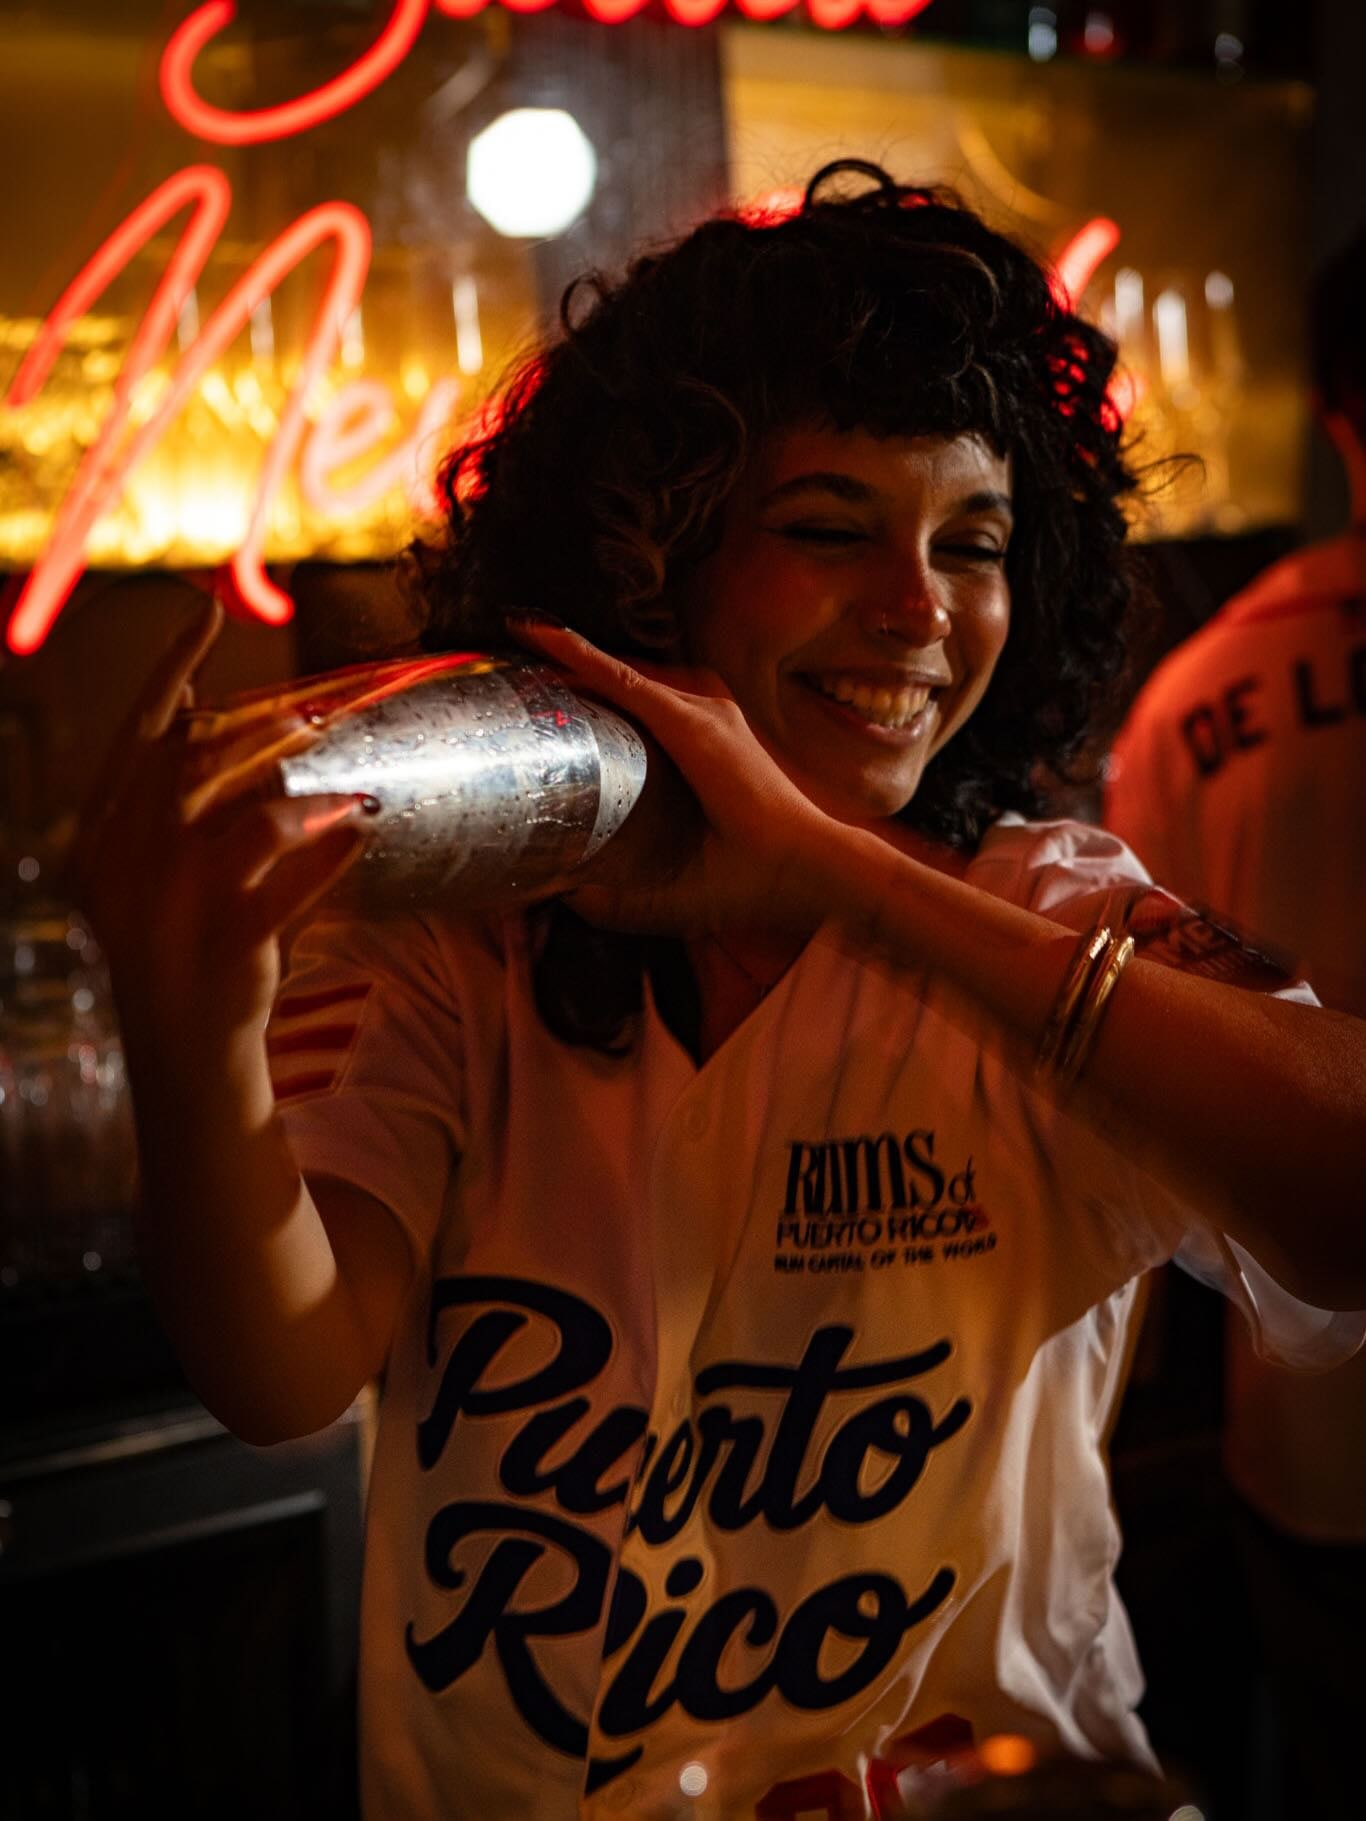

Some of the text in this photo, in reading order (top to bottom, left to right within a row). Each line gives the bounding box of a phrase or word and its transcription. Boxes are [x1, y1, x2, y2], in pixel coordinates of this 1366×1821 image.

[776, 1206, 964, 1249] PUERTO RICO
[808, 1252, 864, 1274] CAPITAL
[871, 1249, 896, 1270] OF
[417, 1275, 972, 1546] Puerto
[405, 1501, 957, 1797] Rico
